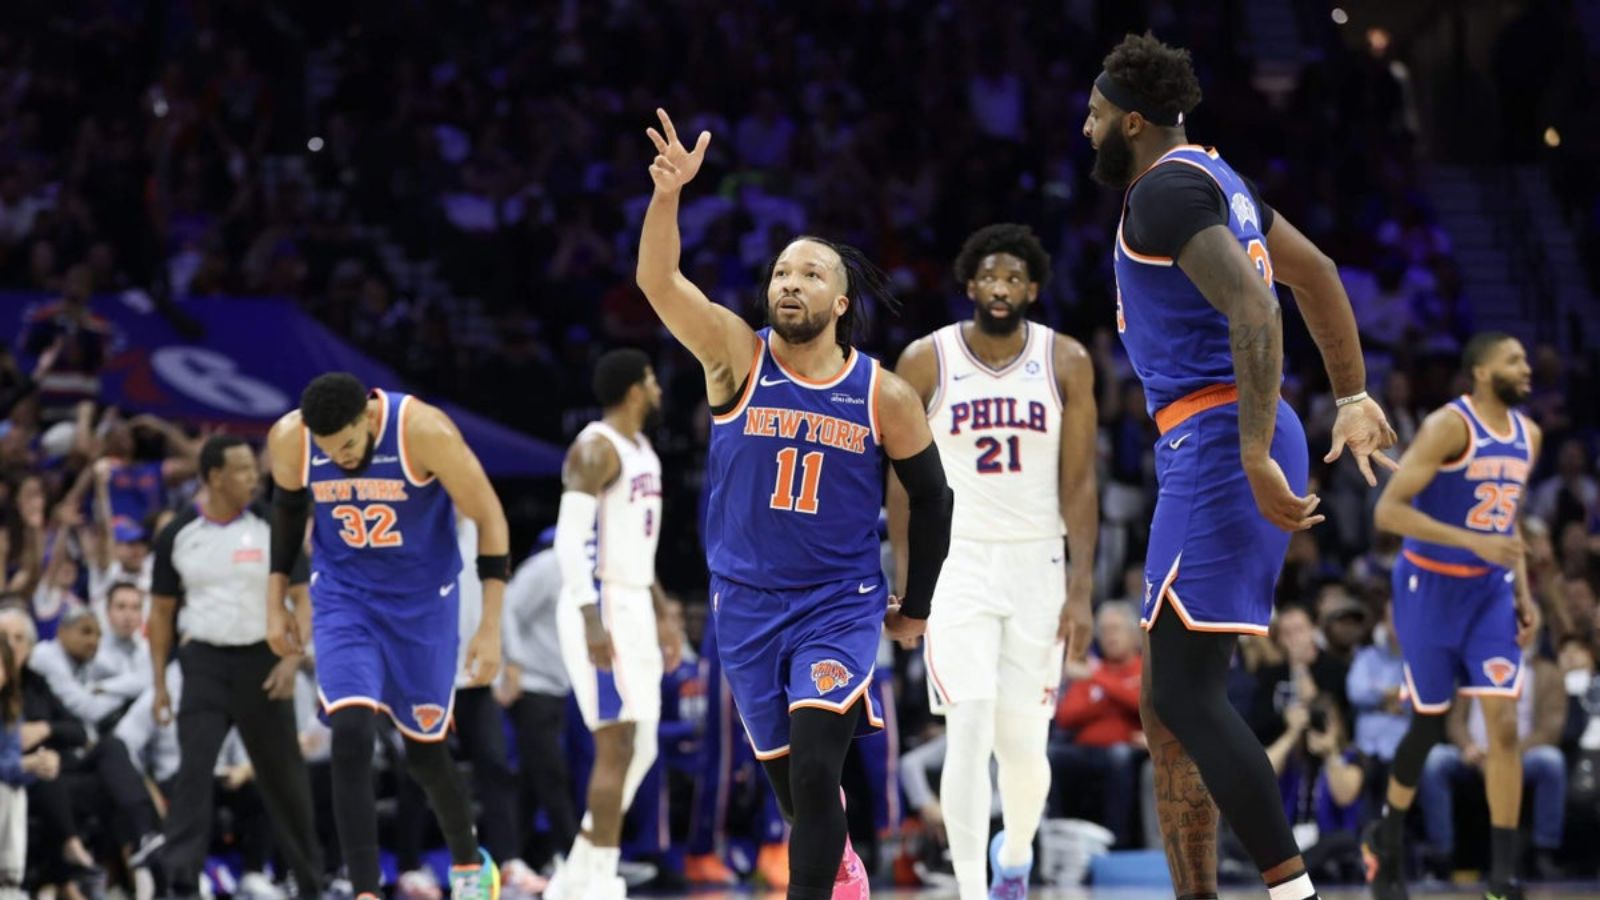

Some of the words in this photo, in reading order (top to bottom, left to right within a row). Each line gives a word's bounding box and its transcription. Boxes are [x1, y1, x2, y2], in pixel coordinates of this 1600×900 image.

[744, 407, 804, 439] NEW
[805, 411, 870, 454] YORK
[950, 397, 1047, 435] PHILA
[974, 435, 1022, 474] 21
[311, 479, 352, 502] NEW
[352, 478, 408, 501] YORK
[769, 447, 824, 514] 11
[331, 504, 403, 549] 32
[1465, 482, 1521, 532] 25
